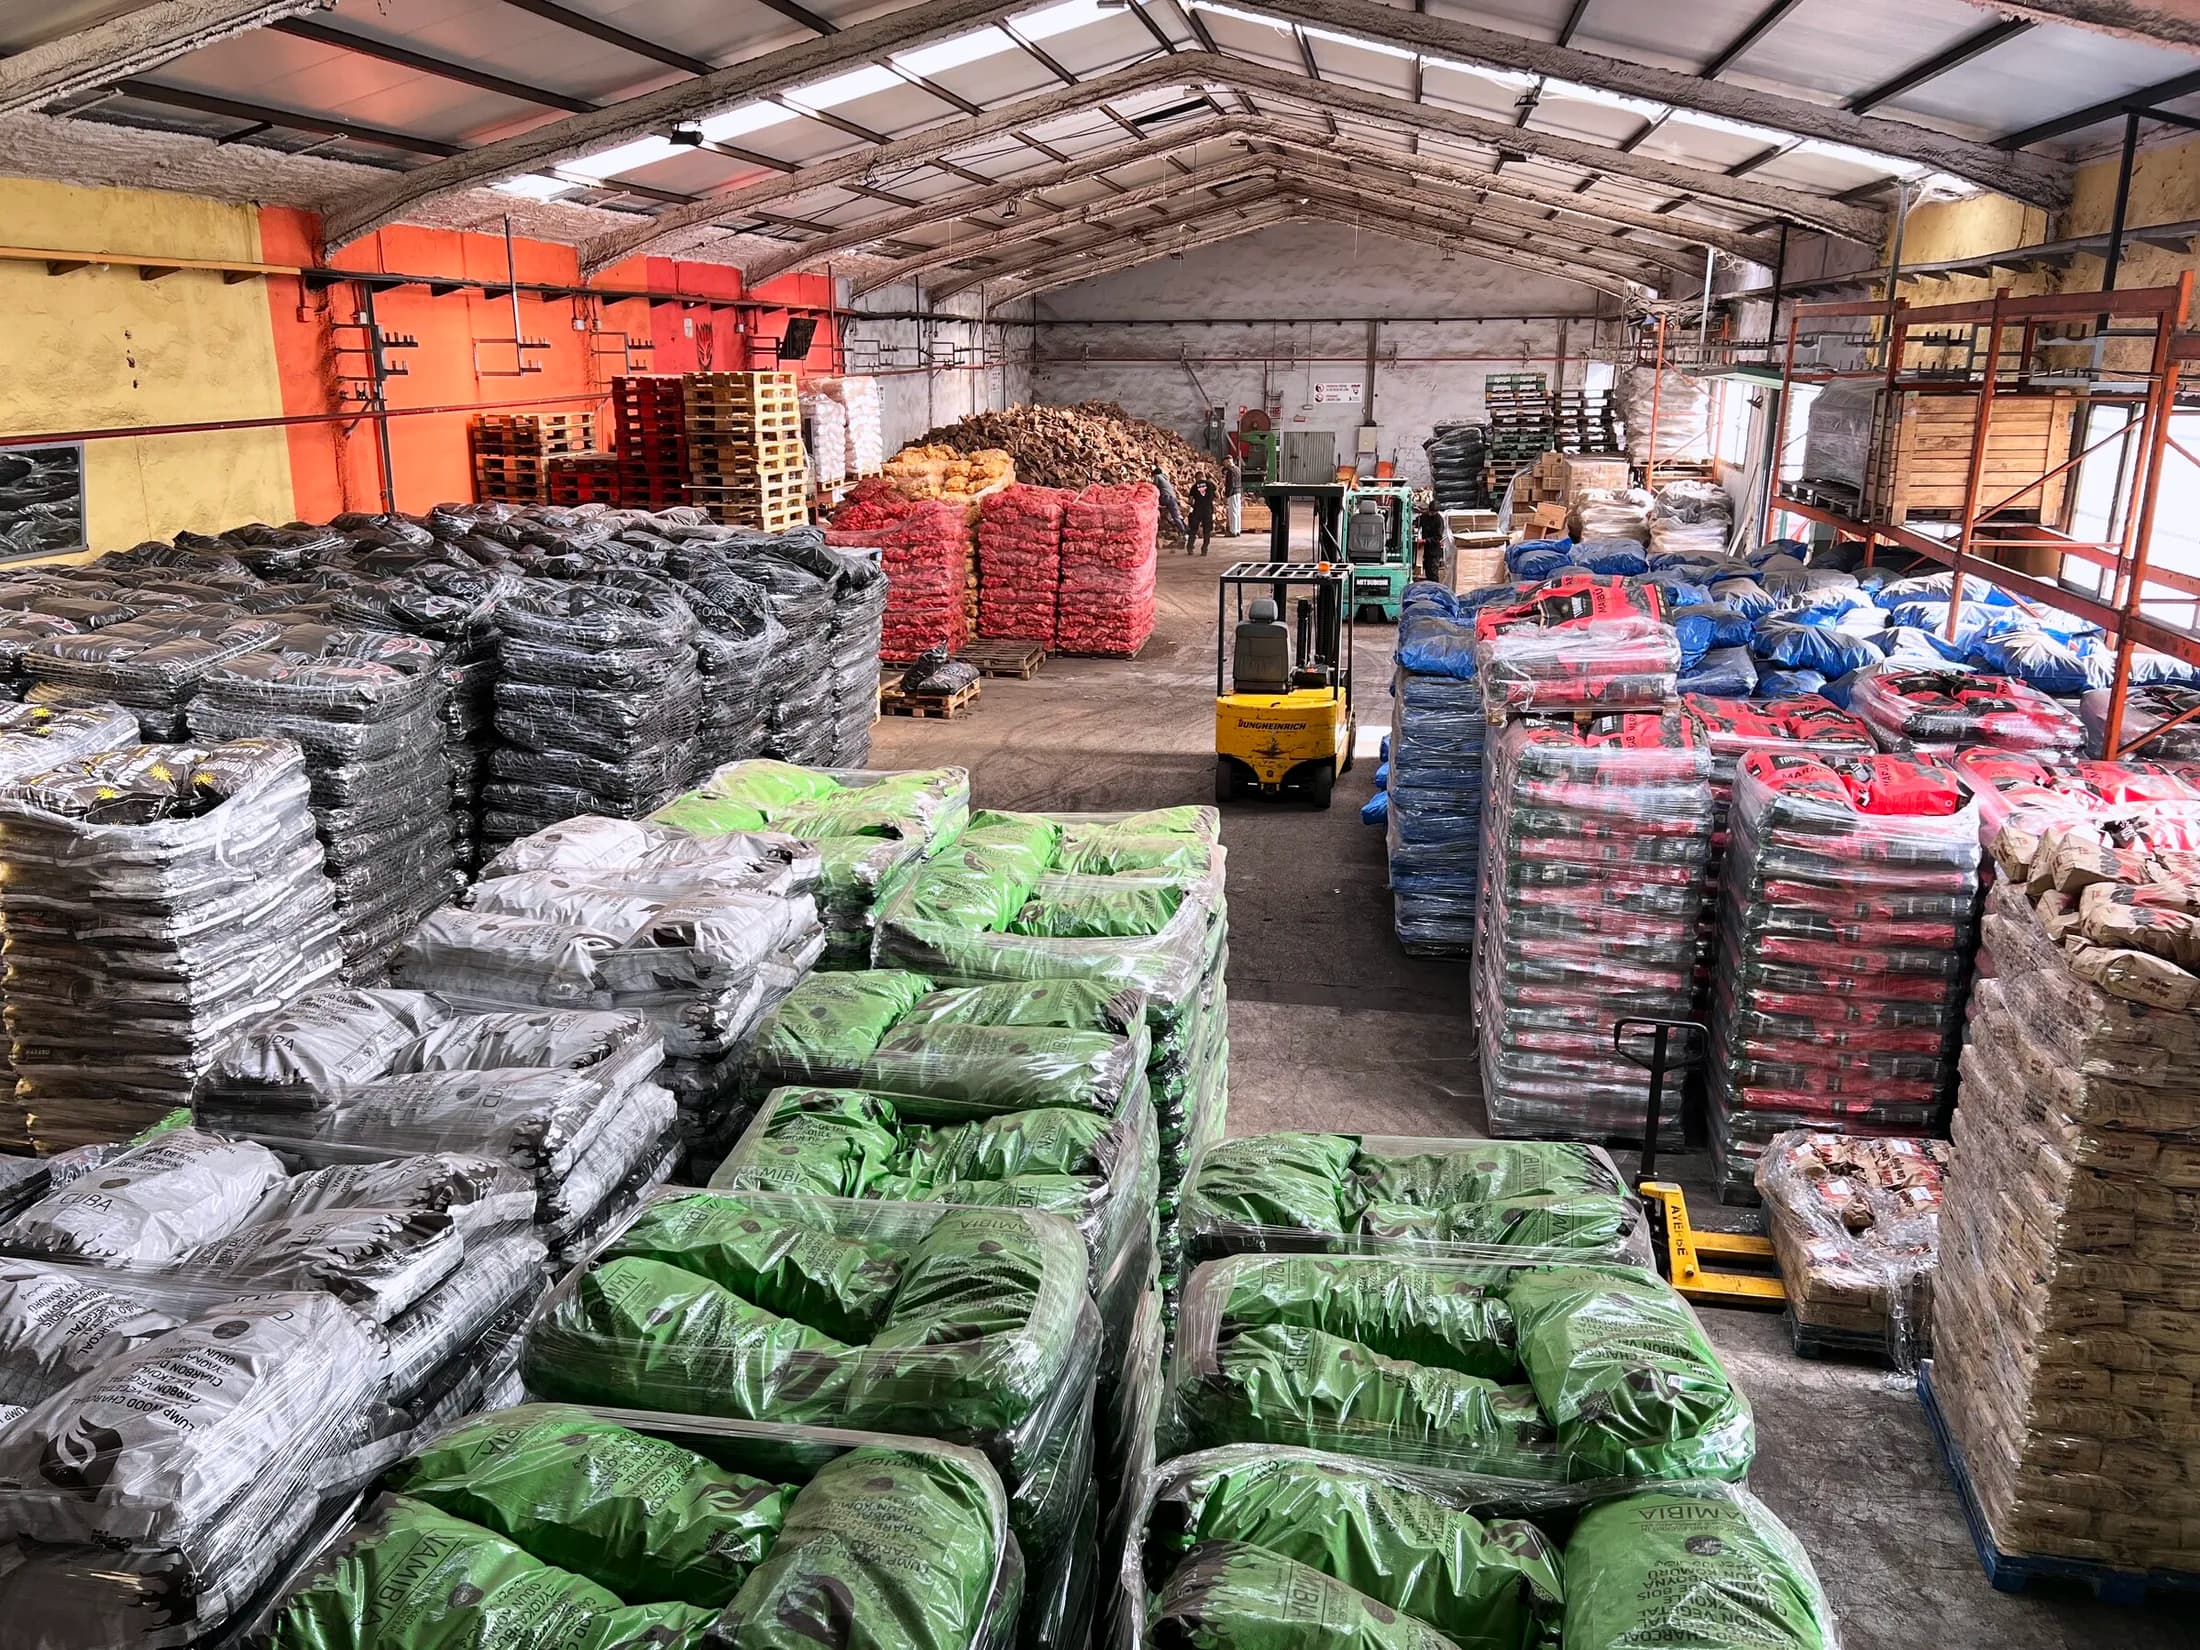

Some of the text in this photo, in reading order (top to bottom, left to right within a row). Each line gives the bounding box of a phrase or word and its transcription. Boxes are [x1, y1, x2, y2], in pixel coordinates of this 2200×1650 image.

[1237, 718, 1307, 731] JUNGHEINRICH
[59, 1192, 113, 1212] CUBA
[204, 1348, 236, 1366] ODUN
[170, 1362, 223, 1387] CHARBON
[126, 1397, 163, 1413] WOOD
[162, 1409, 196, 1433] LUMP
[1639, 1506, 1747, 1521] AMIBIA
[887, 1558, 930, 1575] LUMP
[352, 1532, 450, 1627] NAMIBIA
[1637, 1587, 1672, 1601] BOIS
